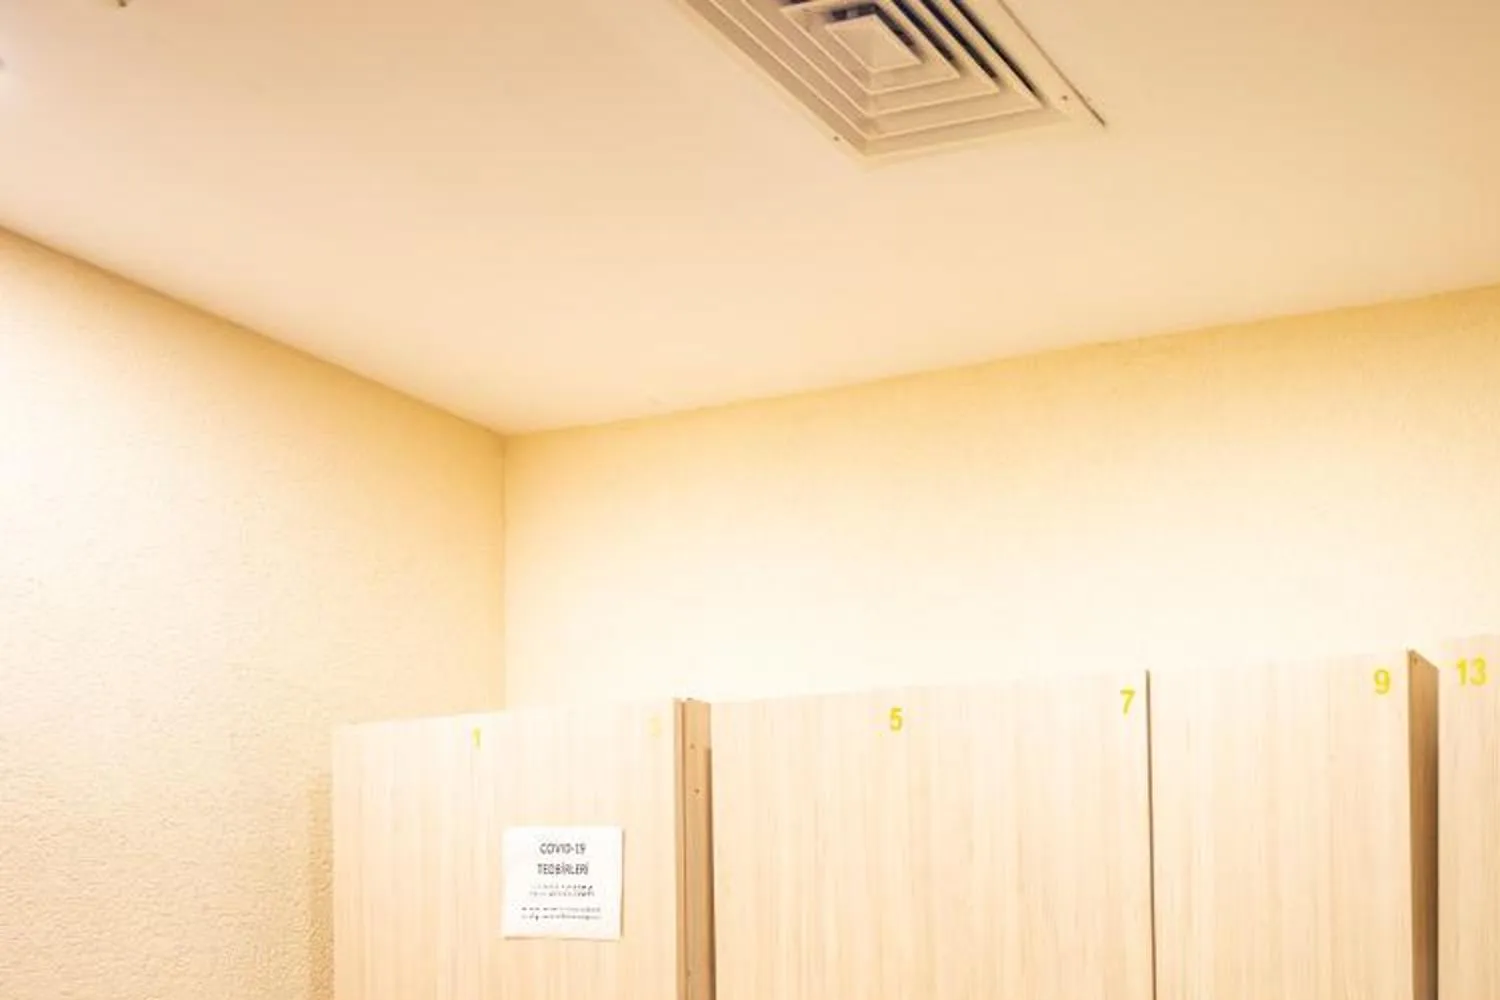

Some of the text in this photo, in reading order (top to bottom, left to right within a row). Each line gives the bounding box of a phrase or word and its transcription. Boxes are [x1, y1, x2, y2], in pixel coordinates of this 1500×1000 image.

[1373, 668, 1391, 695] 9
[1456, 657, 1487, 687] 13
[1119, 687, 1136, 716] 7
[889, 706, 903, 732] 5
[539, 842, 587, 855] COVID-19
